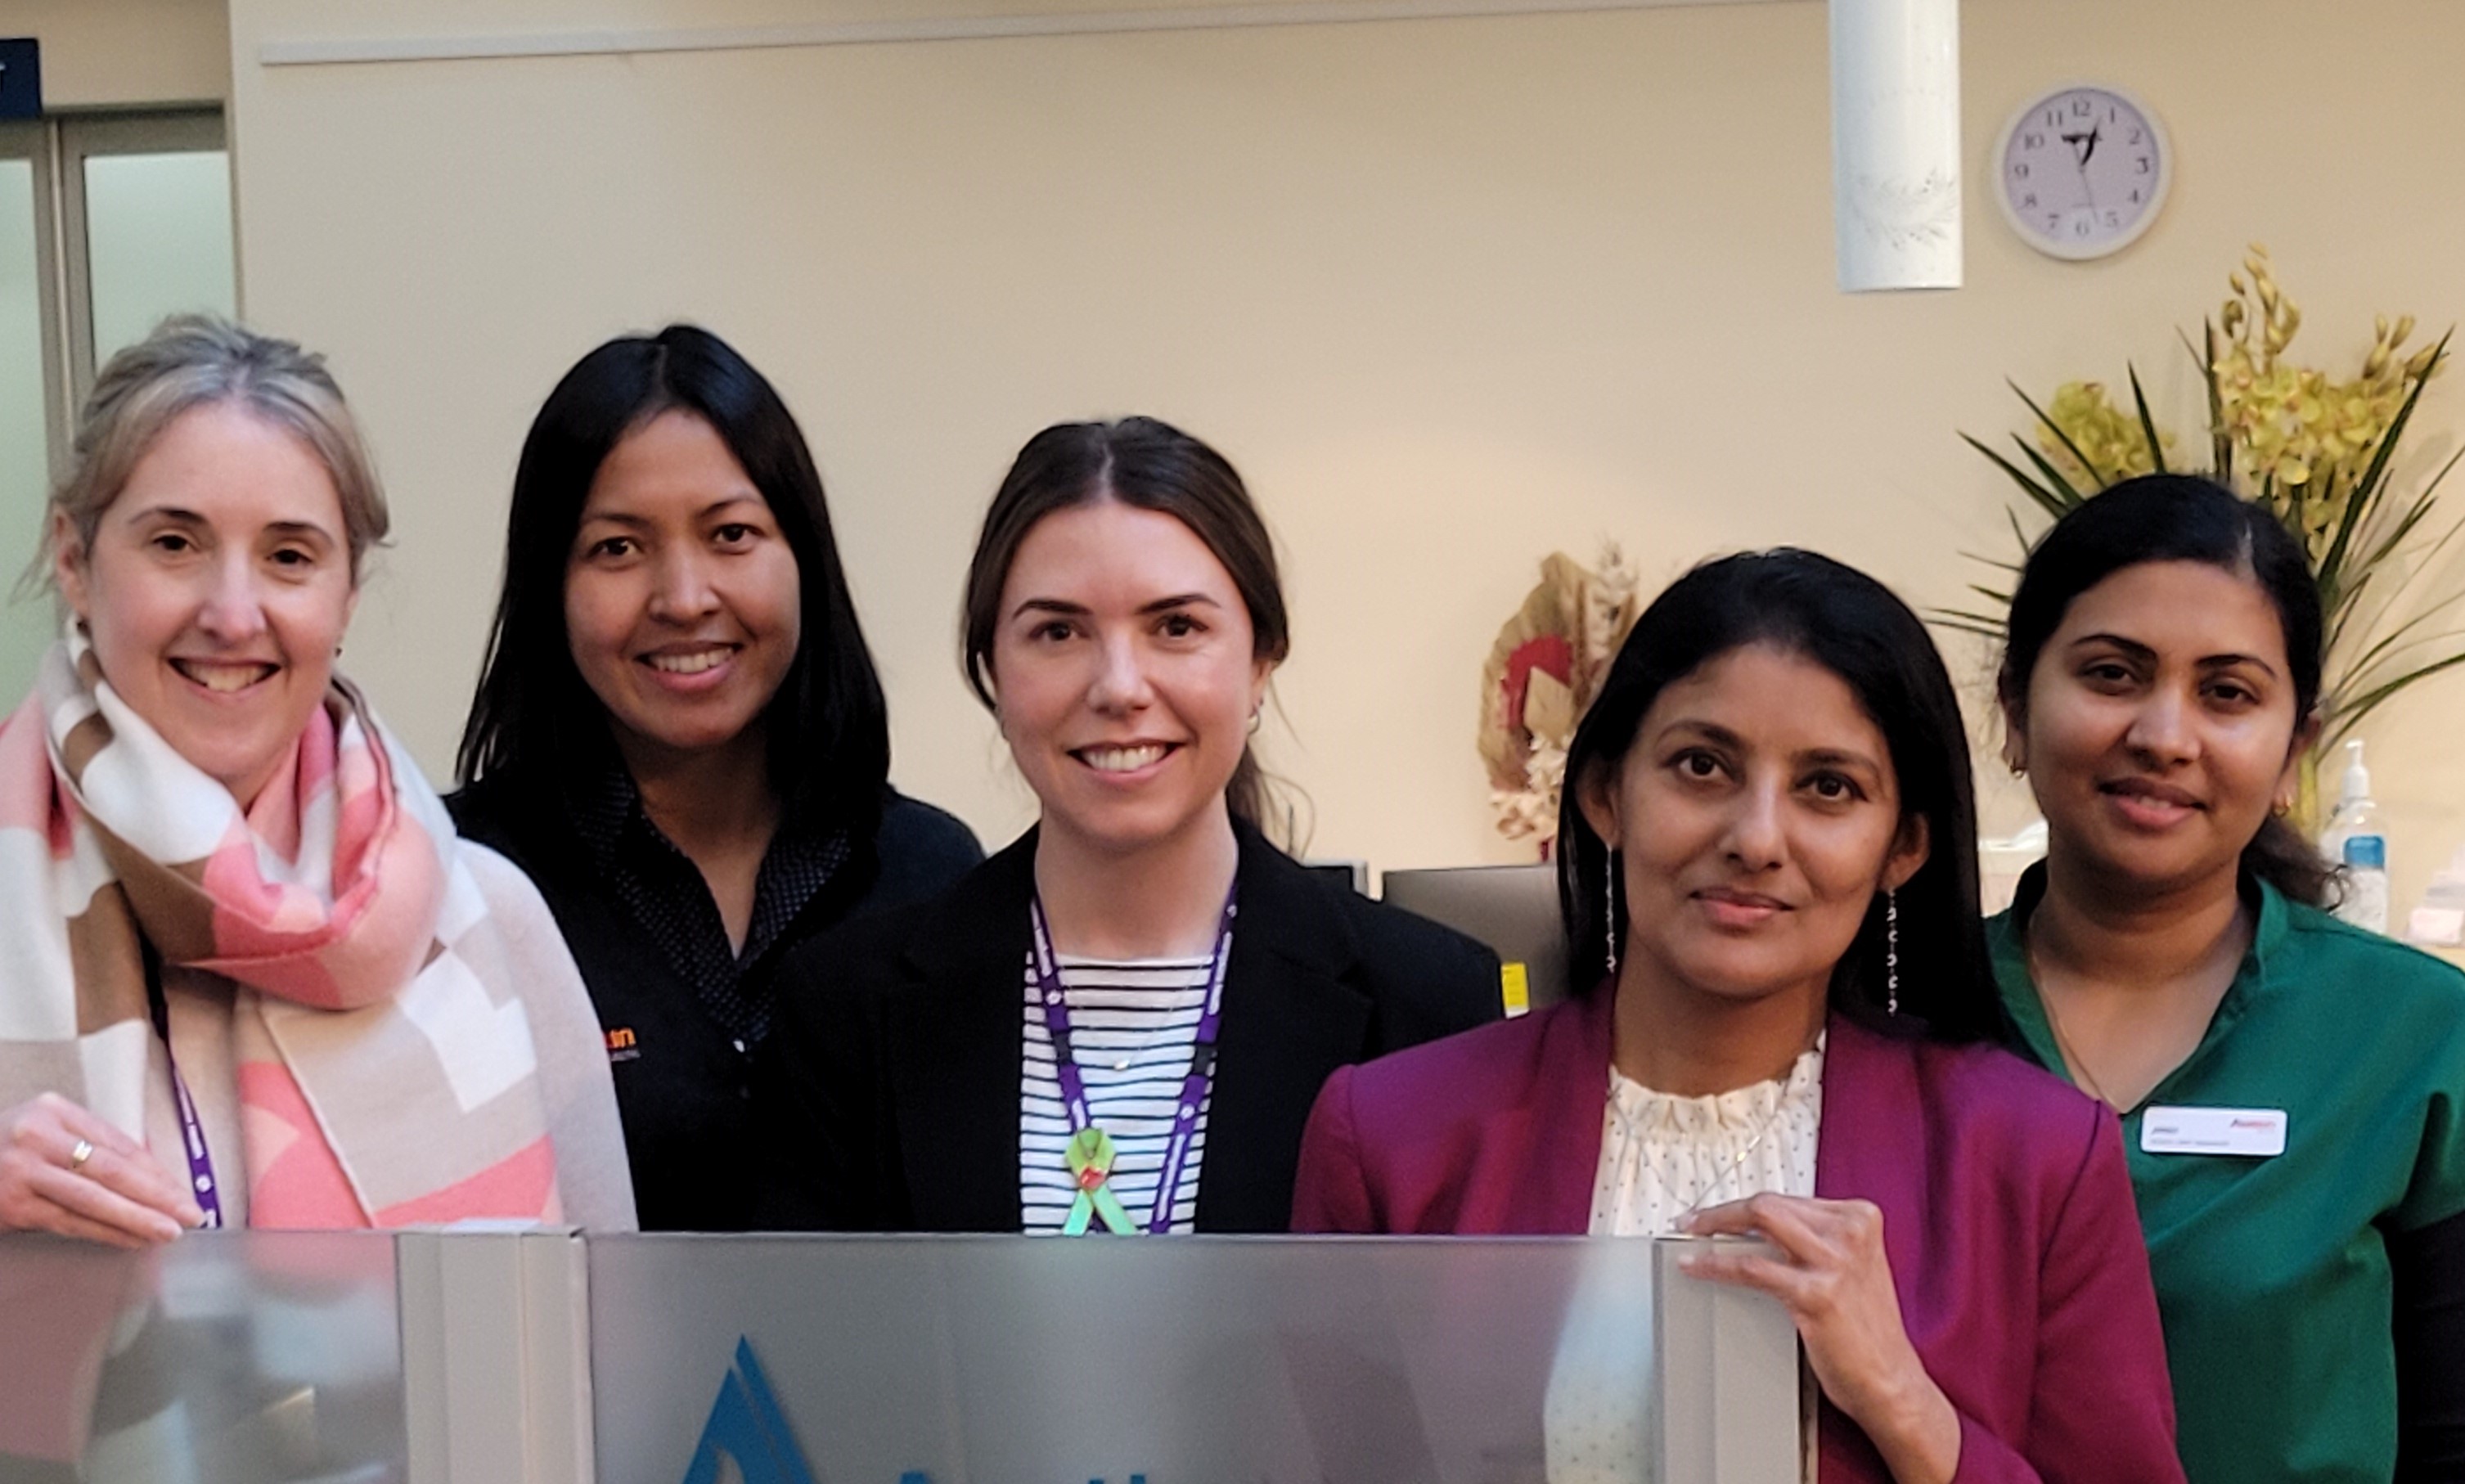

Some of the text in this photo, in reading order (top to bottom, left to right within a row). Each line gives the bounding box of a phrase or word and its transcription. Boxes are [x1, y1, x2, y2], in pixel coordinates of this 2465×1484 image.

[2072, 101, 2089, 116] 12
[2047, 110, 2062, 126] 11
[2025, 133, 2044, 149] 10
[2130, 129, 2140, 144] 2
[2014, 164, 2029, 178] 9
[2135, 158, 2149, 174] 3
[2025, 194, 2037, 207] 8
[2128, 190, 2139, 204] 4
[2048, 214, 2059, 228] 7
[2106, 212, 2118, 227] 5
[2076, 221, 2089, 236] 6
